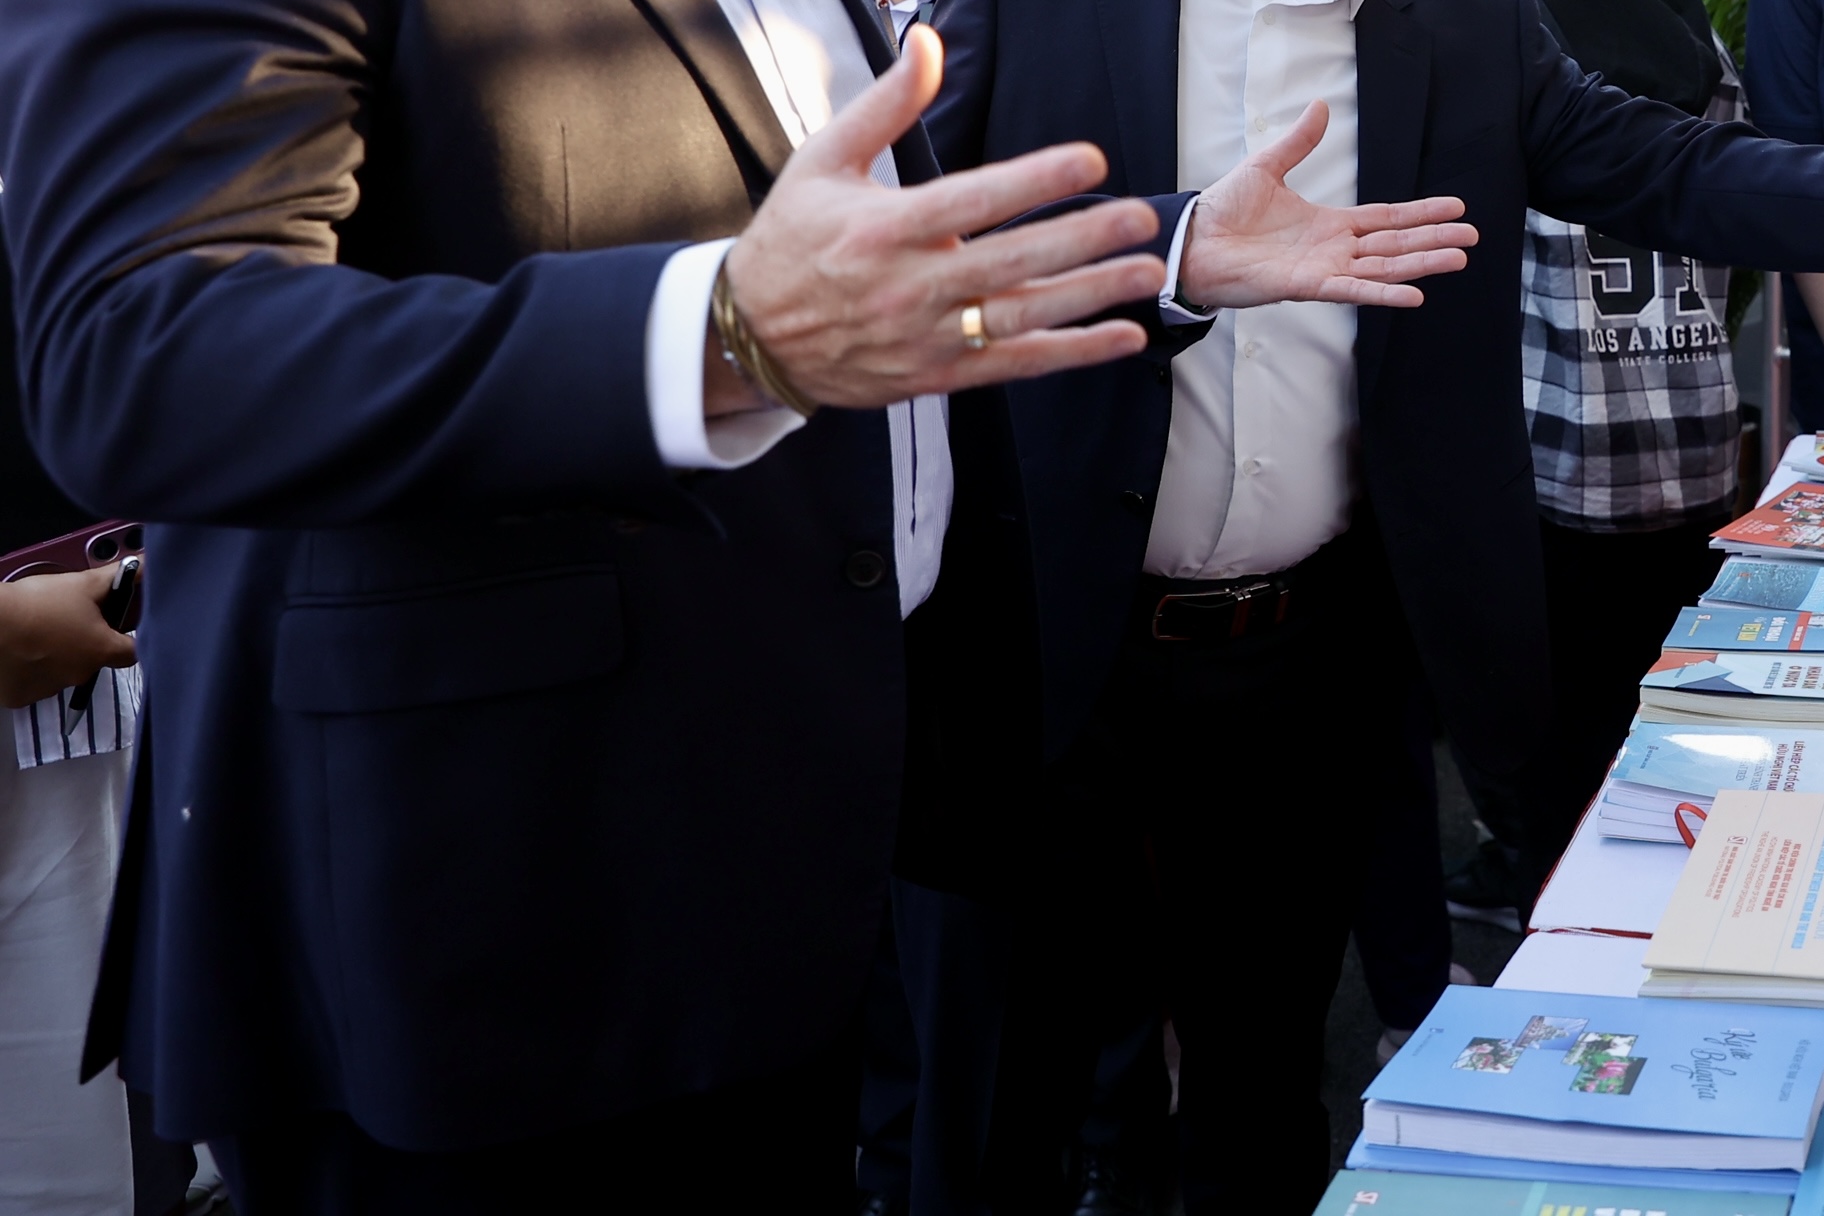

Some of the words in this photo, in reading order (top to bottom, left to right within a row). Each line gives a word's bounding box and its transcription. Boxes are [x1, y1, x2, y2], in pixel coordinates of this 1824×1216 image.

[1586, 327, 1619, 353] LOS
[1628, 321, 1730, 351] ANGEL
[1619, 356, 1651, 368] STATE
[1659, 351, 1713, 365] COLLEGE
[1775, 743, 1789, 755] HỮU
[1791, 740, 1806, 752] LIÊN
[1787, 752, 1803, 765] HIỆP
[1766, 768, 1783, 780] VIỆT
[1787, 764, 1803, 775] CÁC
[1765, 779, 1780, 791] NAM
[1782, 781, 1799, 792] CHỨ
[1671, 1047, 1738, 1101] Bulgaria
